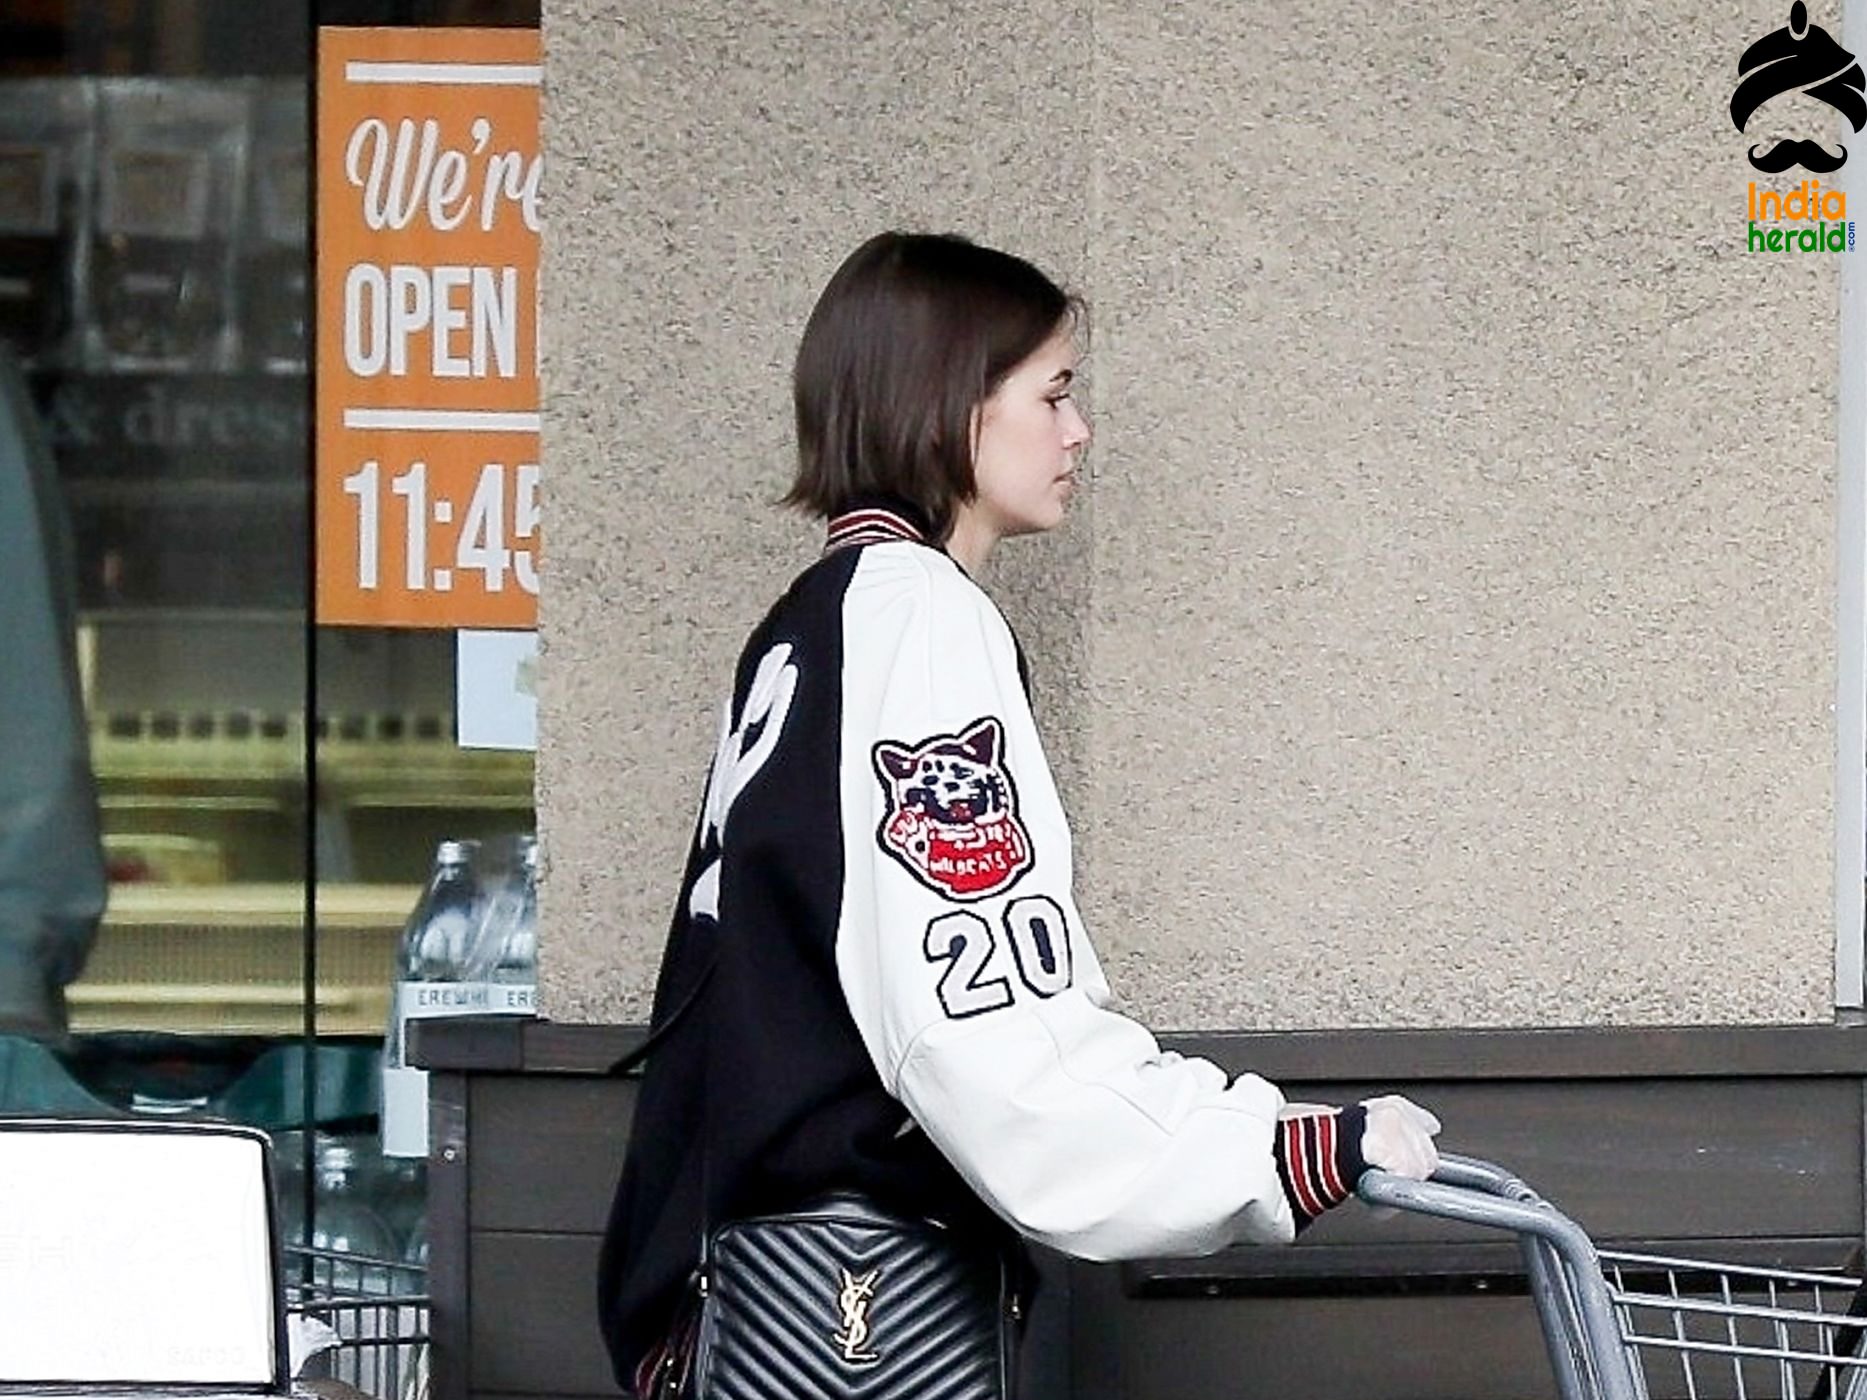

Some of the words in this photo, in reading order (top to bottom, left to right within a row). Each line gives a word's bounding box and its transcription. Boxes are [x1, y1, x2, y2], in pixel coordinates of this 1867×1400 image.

[345, 117, 541, 231] We're
[344, 262, 518, 380] OPEN
[343, 460, 541, 596] 11:45
[922, 894, 1074, 1021] 20
